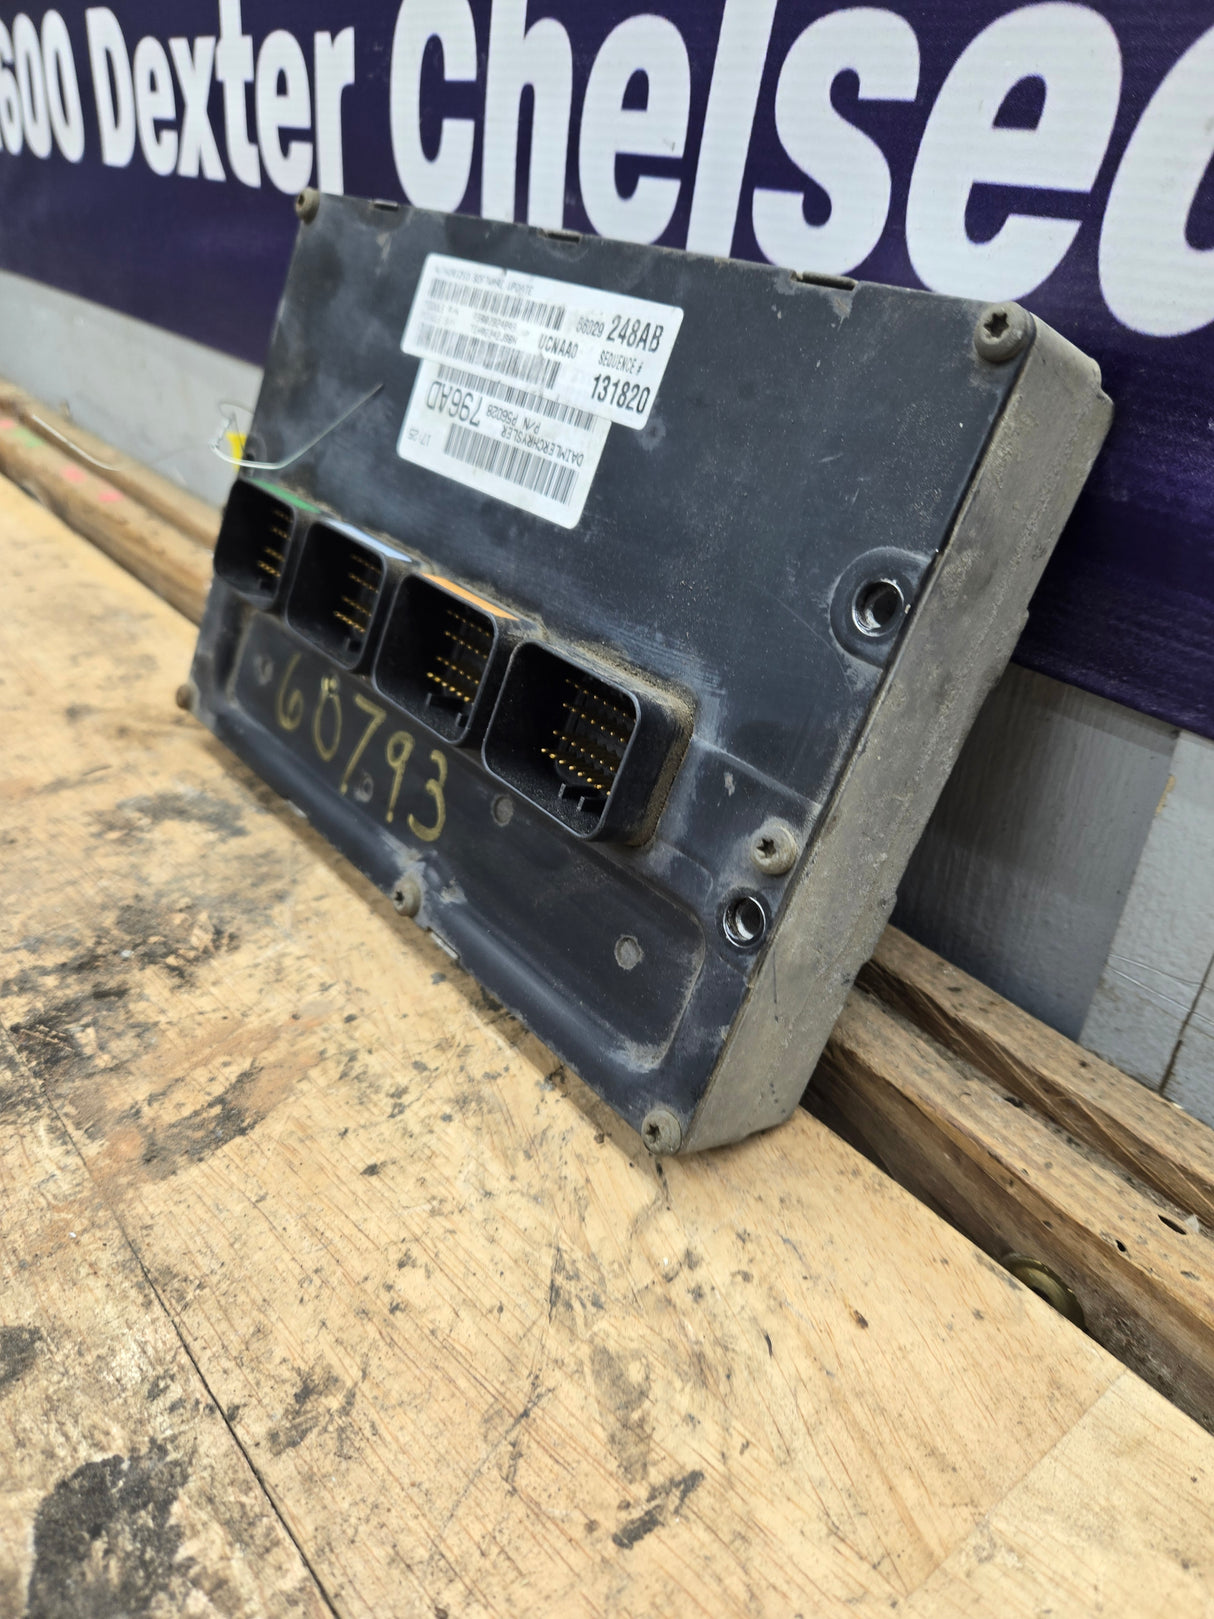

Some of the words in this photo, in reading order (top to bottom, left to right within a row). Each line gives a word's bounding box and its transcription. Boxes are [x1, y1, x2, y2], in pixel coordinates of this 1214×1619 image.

[0, 9, 85, 163] 600
[85, 0, 355, 196] Dexter
[606, 314, 664, 353] 248AB
[598, 350, 637, 374] SEQUENCE
[426, 381, 484, 427] 796AD
[591, 373, 651, 414] 131820
[500, 424, 585, 467] DAIMLERCHRYSLER
[523, 417, 542, 435] P/N
[276, 652, 448, 842] 60793
